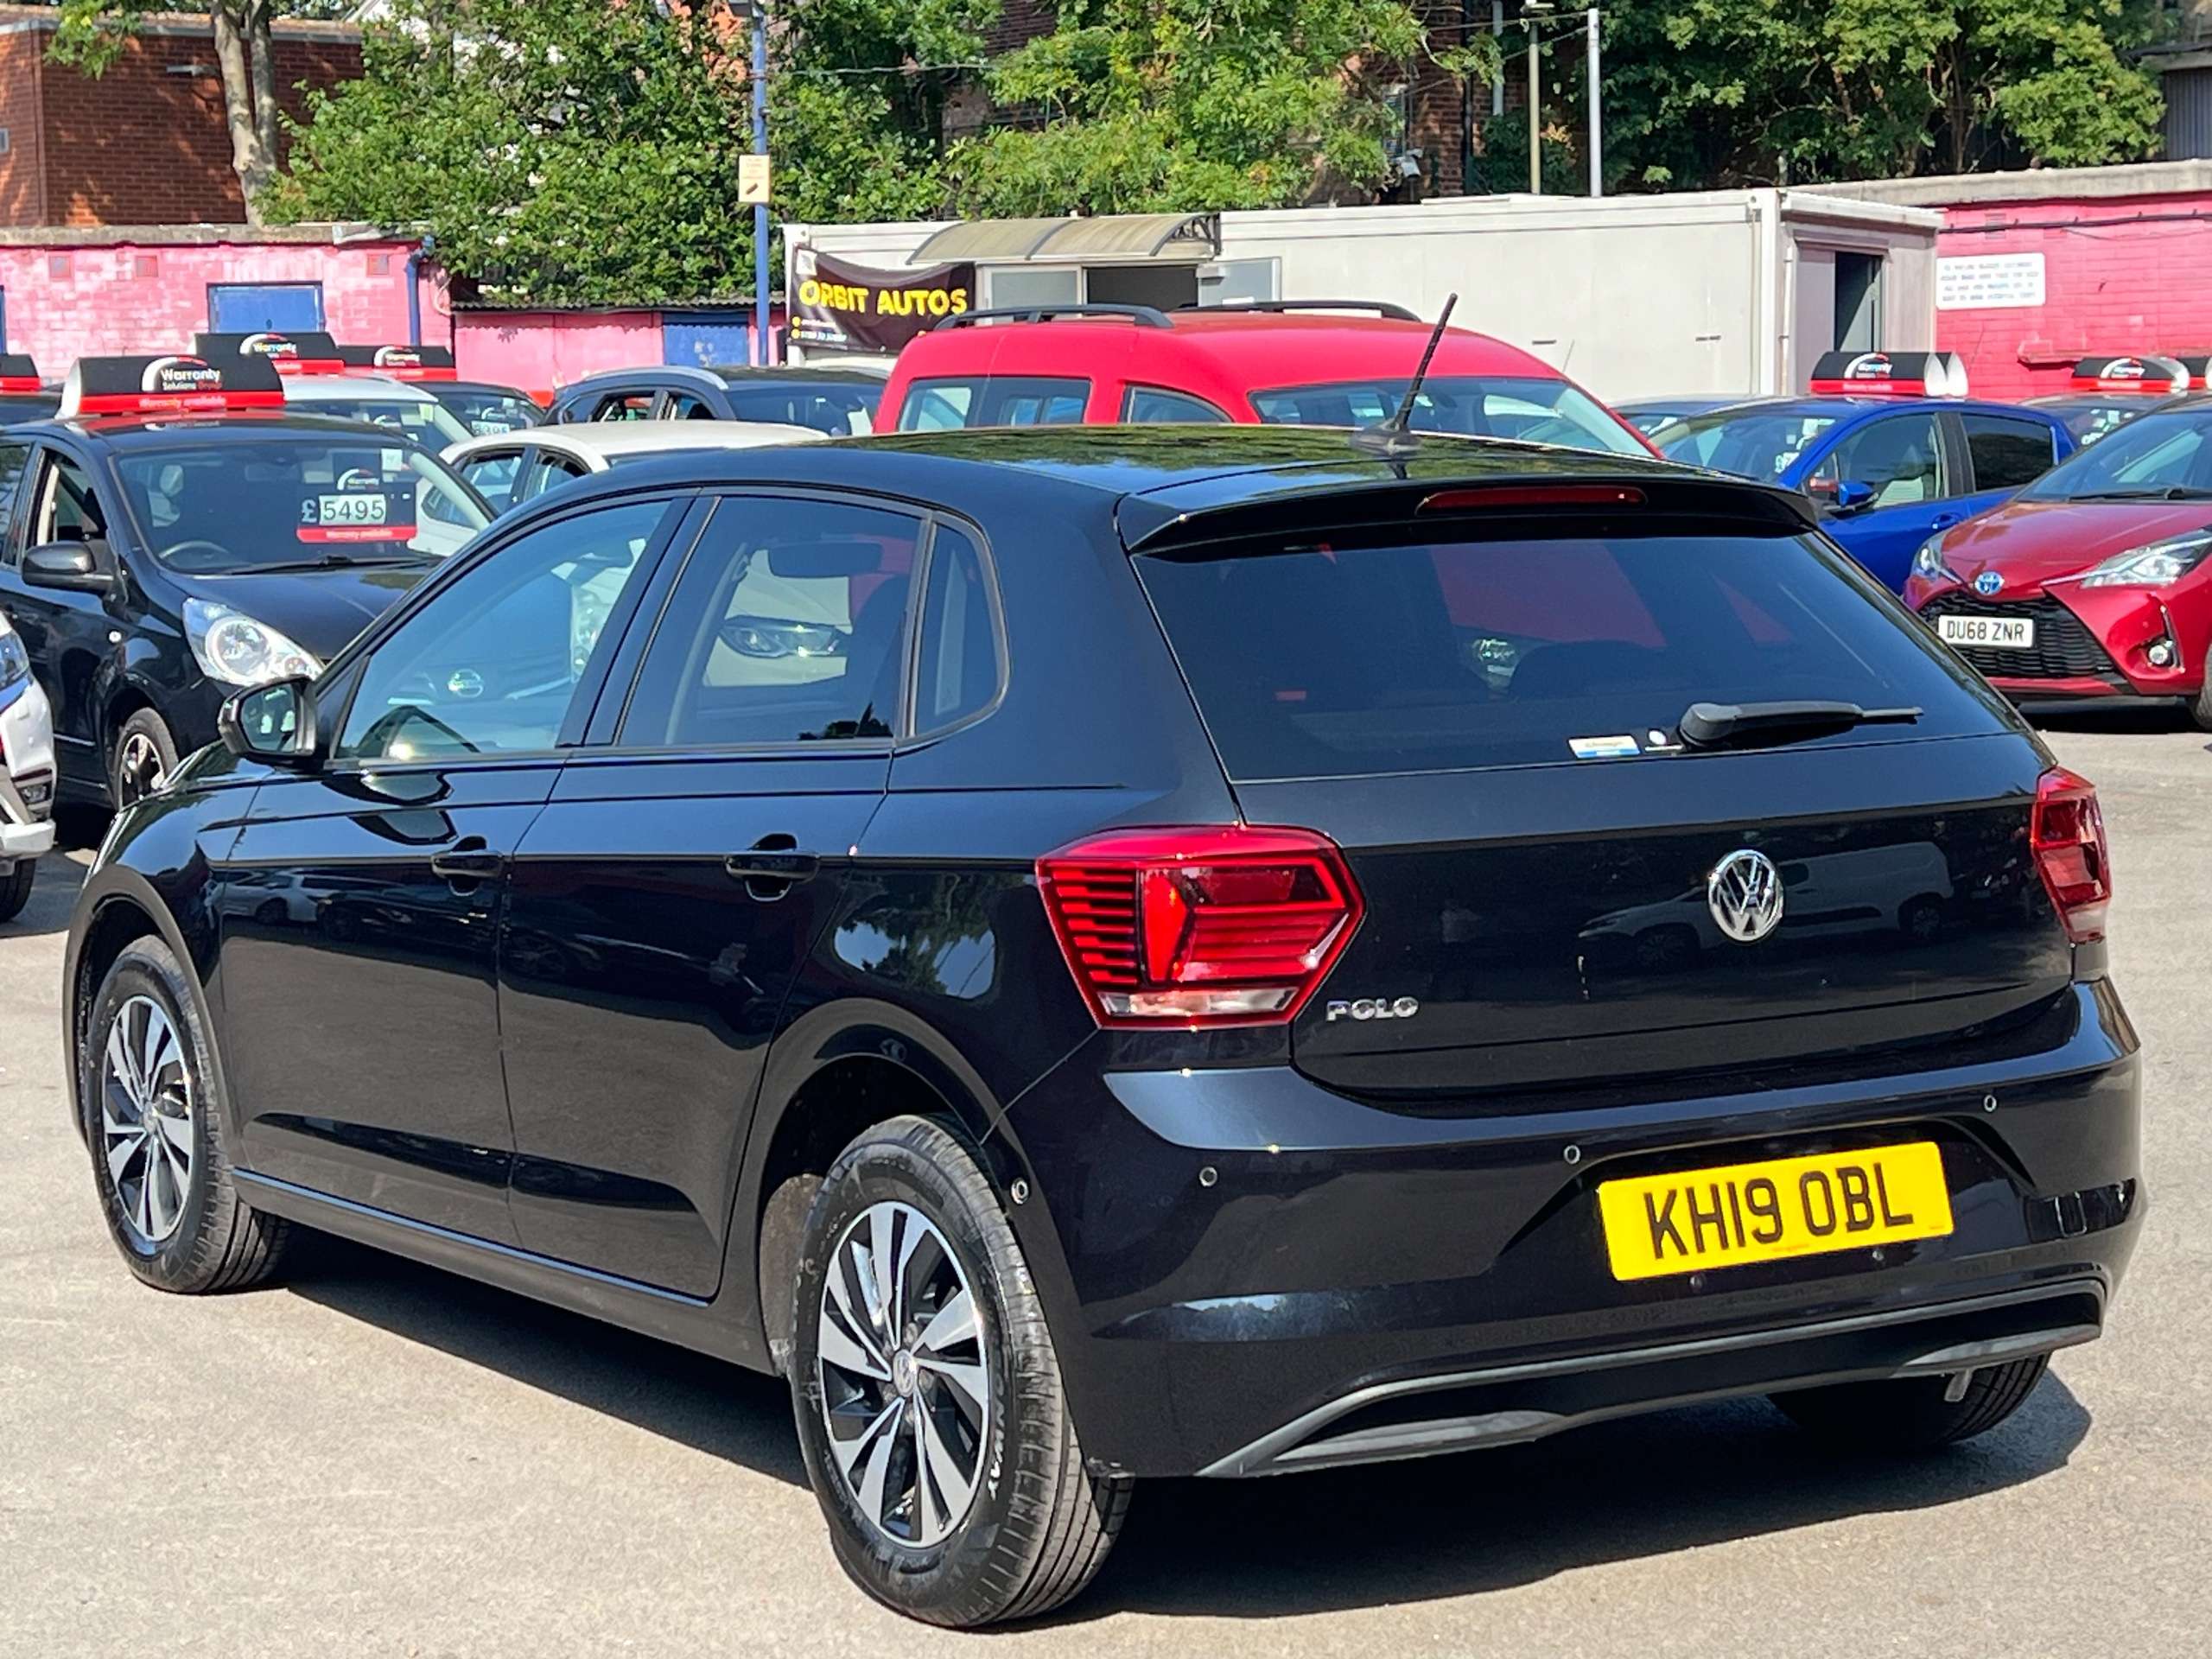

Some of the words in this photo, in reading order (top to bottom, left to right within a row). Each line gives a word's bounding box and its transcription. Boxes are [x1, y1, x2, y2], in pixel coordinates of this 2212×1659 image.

[798, 279, 869, 315] ORBIT
[876, 288, 968, 316] AUTOS
[160, 368, 221, 383] Warranty
[1947, 620, 1987, 640] DU68
[1991, 622, 2024, 641] ZNR
[1326, 996, 1419, 1020] POLO
[1643, 1177, 1784, 1260] KH19
[1798, 1161, 1914, 1237] OBL
